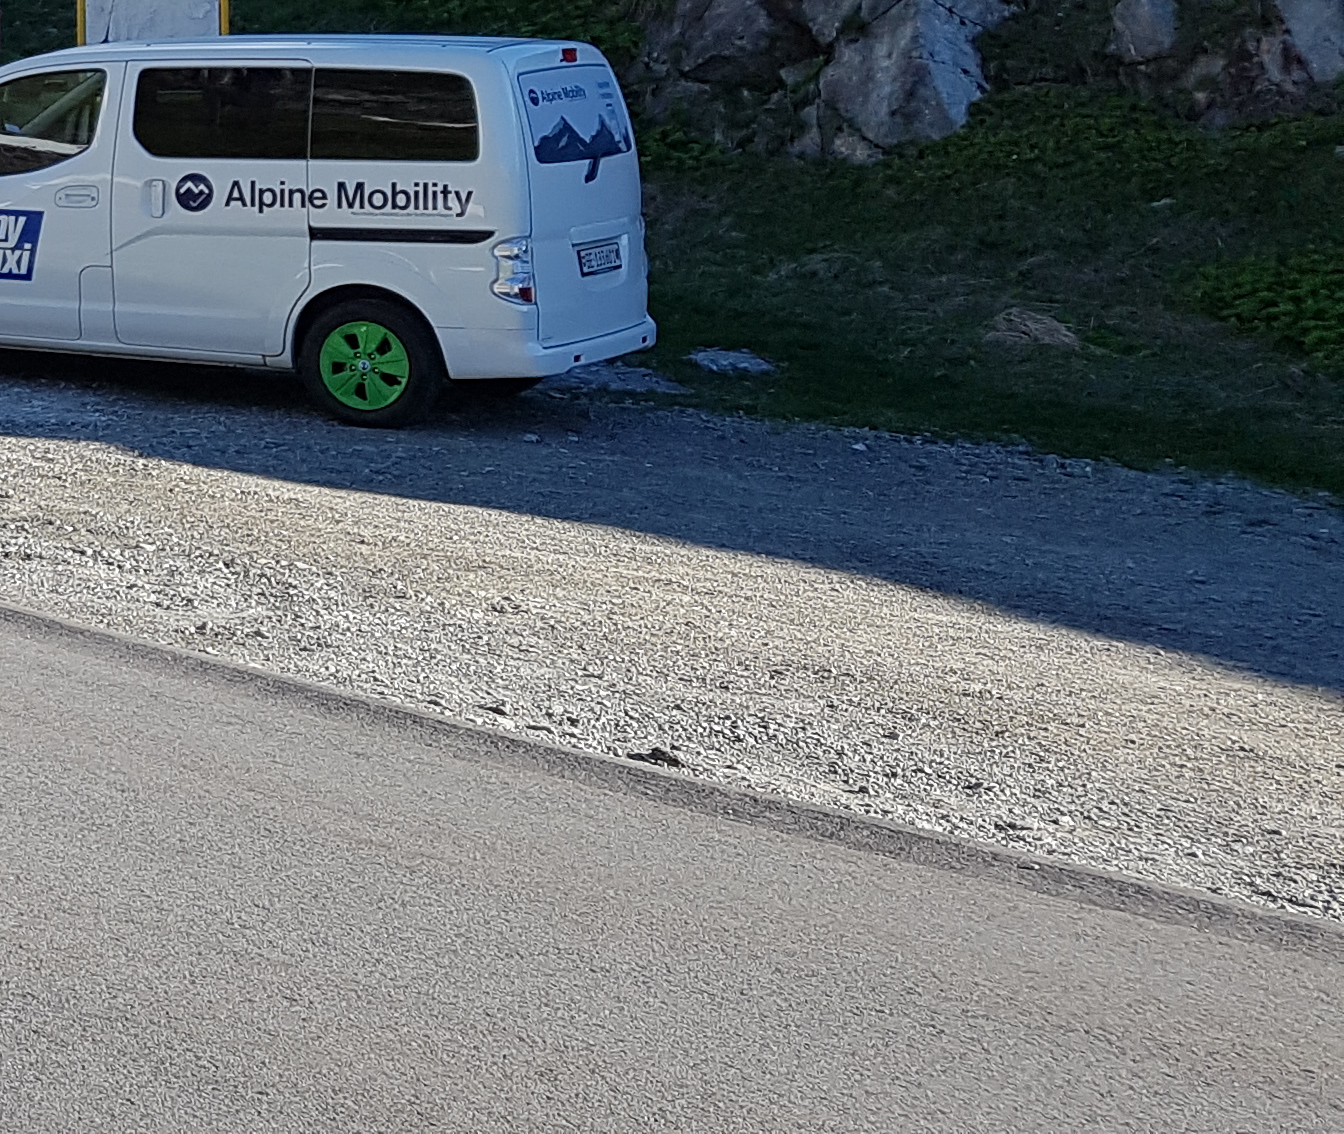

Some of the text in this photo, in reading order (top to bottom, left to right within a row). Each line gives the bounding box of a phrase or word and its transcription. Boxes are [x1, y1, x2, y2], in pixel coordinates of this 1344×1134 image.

[540, 89, 564, 104] Alpine
[224, 180, 474, 218] Alpine Mobility
